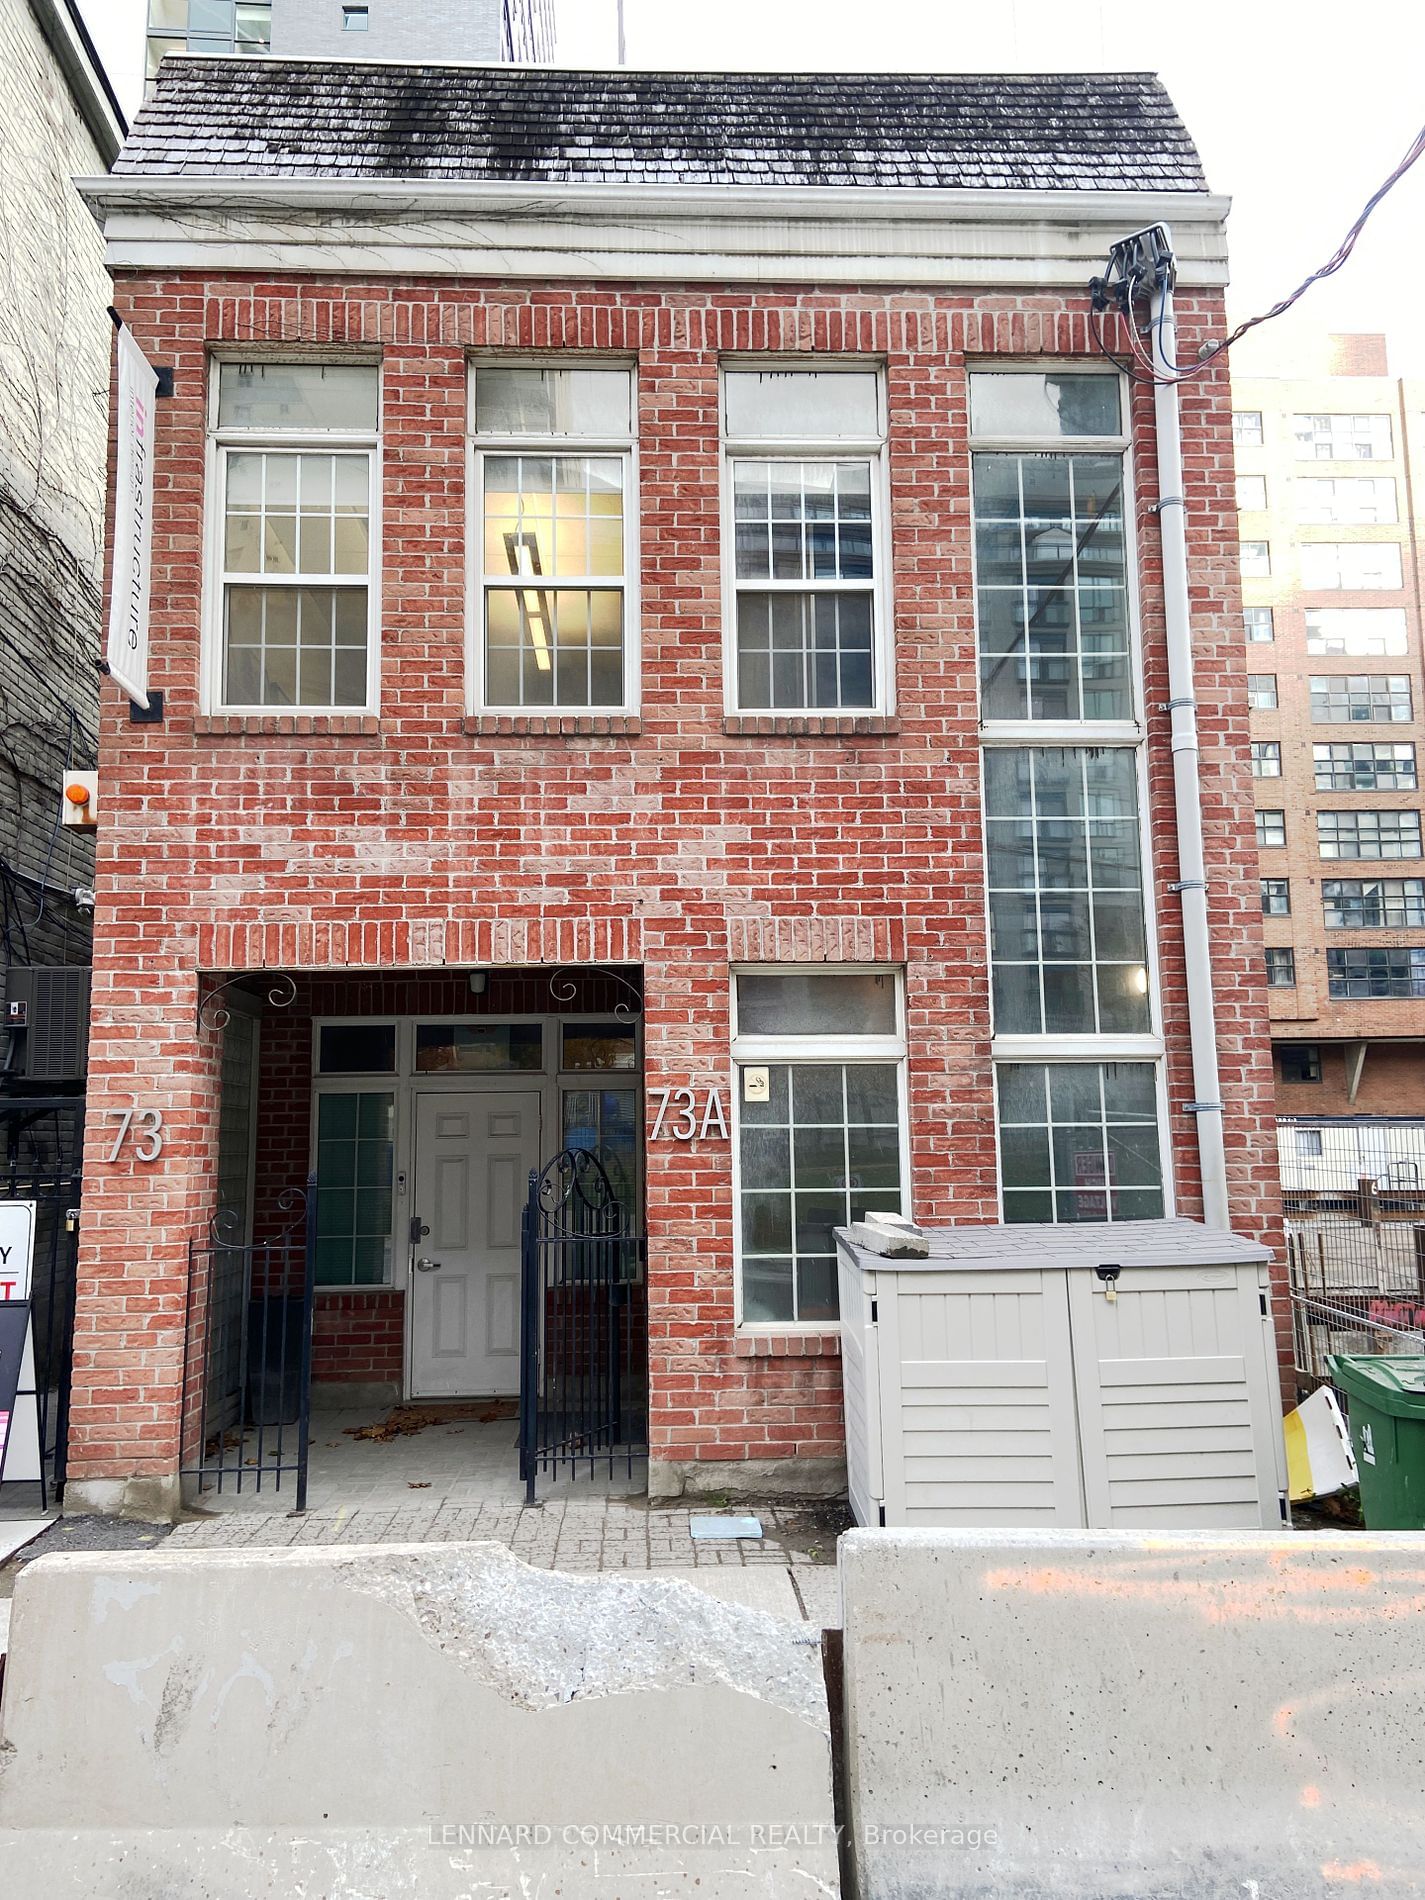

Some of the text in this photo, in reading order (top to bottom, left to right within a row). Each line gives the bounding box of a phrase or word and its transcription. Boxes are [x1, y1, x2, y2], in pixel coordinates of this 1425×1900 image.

[128, 396, 147, 649] infrastructure
[107, 1109, 162, 1162] 73
[647, 1088, 729, 1140] 73A
